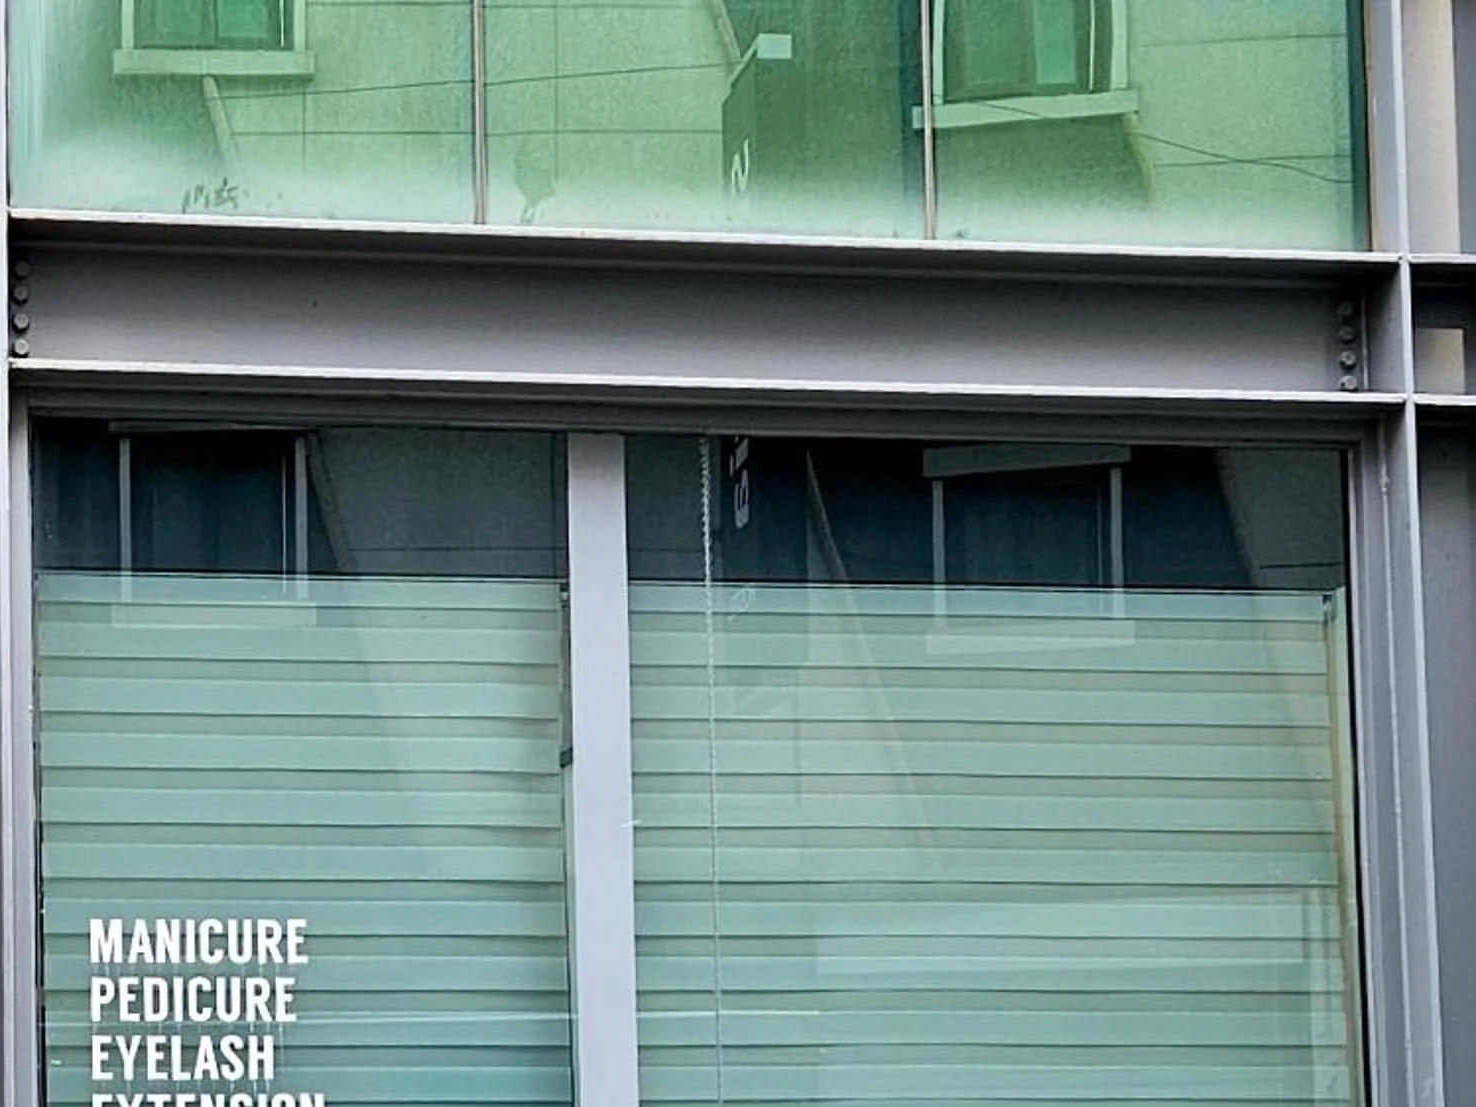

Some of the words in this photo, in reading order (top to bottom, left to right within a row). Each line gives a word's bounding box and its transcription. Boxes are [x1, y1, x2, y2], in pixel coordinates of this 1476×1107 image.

[88, 917, 310, 965] MANICURE
[90, 976, 298, 1023] PEDICURE
[91, 1035, 275, 1081] EYELASH
